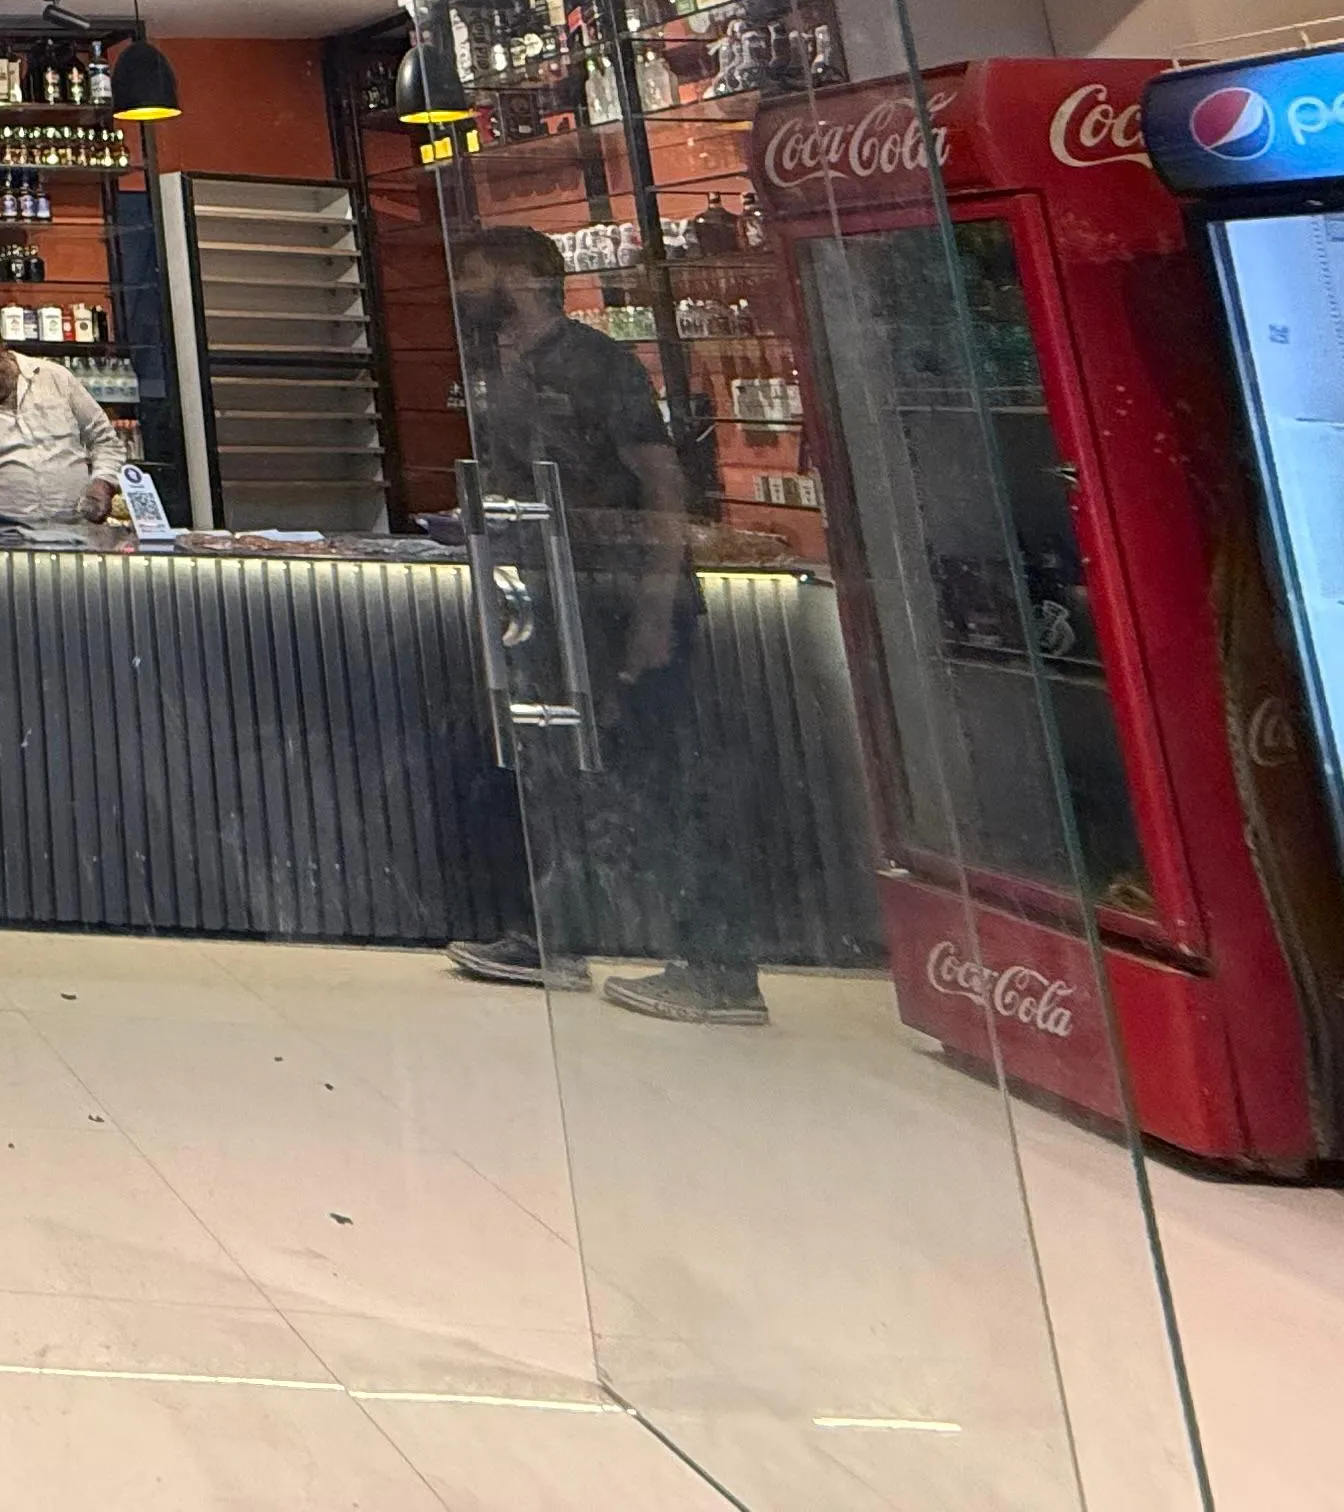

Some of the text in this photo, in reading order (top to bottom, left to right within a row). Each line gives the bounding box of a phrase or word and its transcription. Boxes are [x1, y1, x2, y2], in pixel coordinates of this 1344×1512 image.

[765, 92, 957, 188] Coca-Cola
[1050, 83, 1153, 169] Coc
[927, 941, 1077, 1037] Coca-Cola
